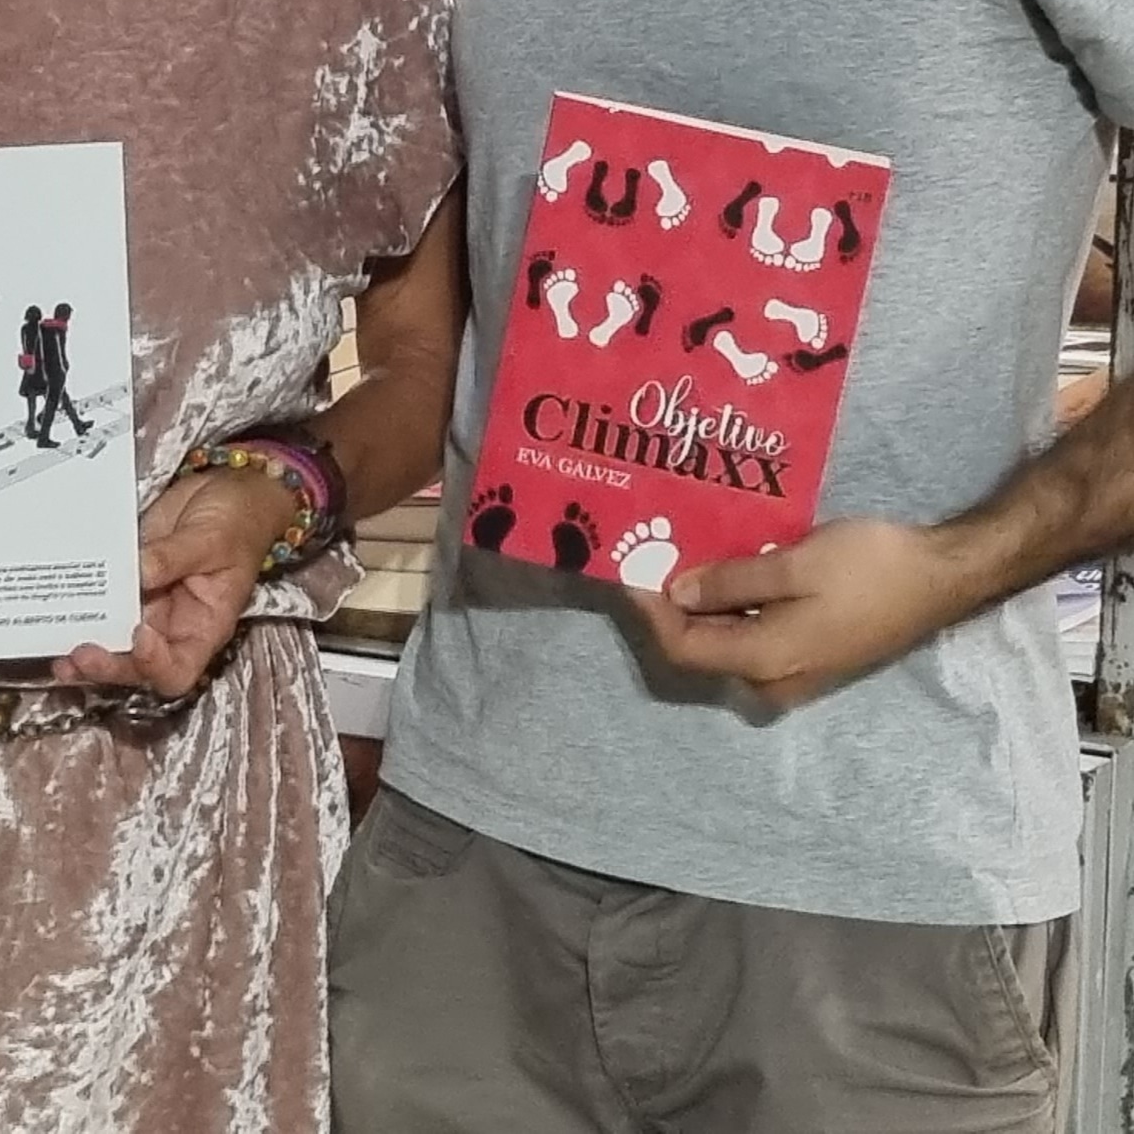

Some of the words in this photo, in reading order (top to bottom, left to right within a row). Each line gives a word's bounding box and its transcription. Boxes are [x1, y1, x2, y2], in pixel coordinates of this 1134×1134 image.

[515, 446, 552, 471] EVA
[522, 392, 792, 498] Climaxx
[629, 374, 791, 467] Objetivo
